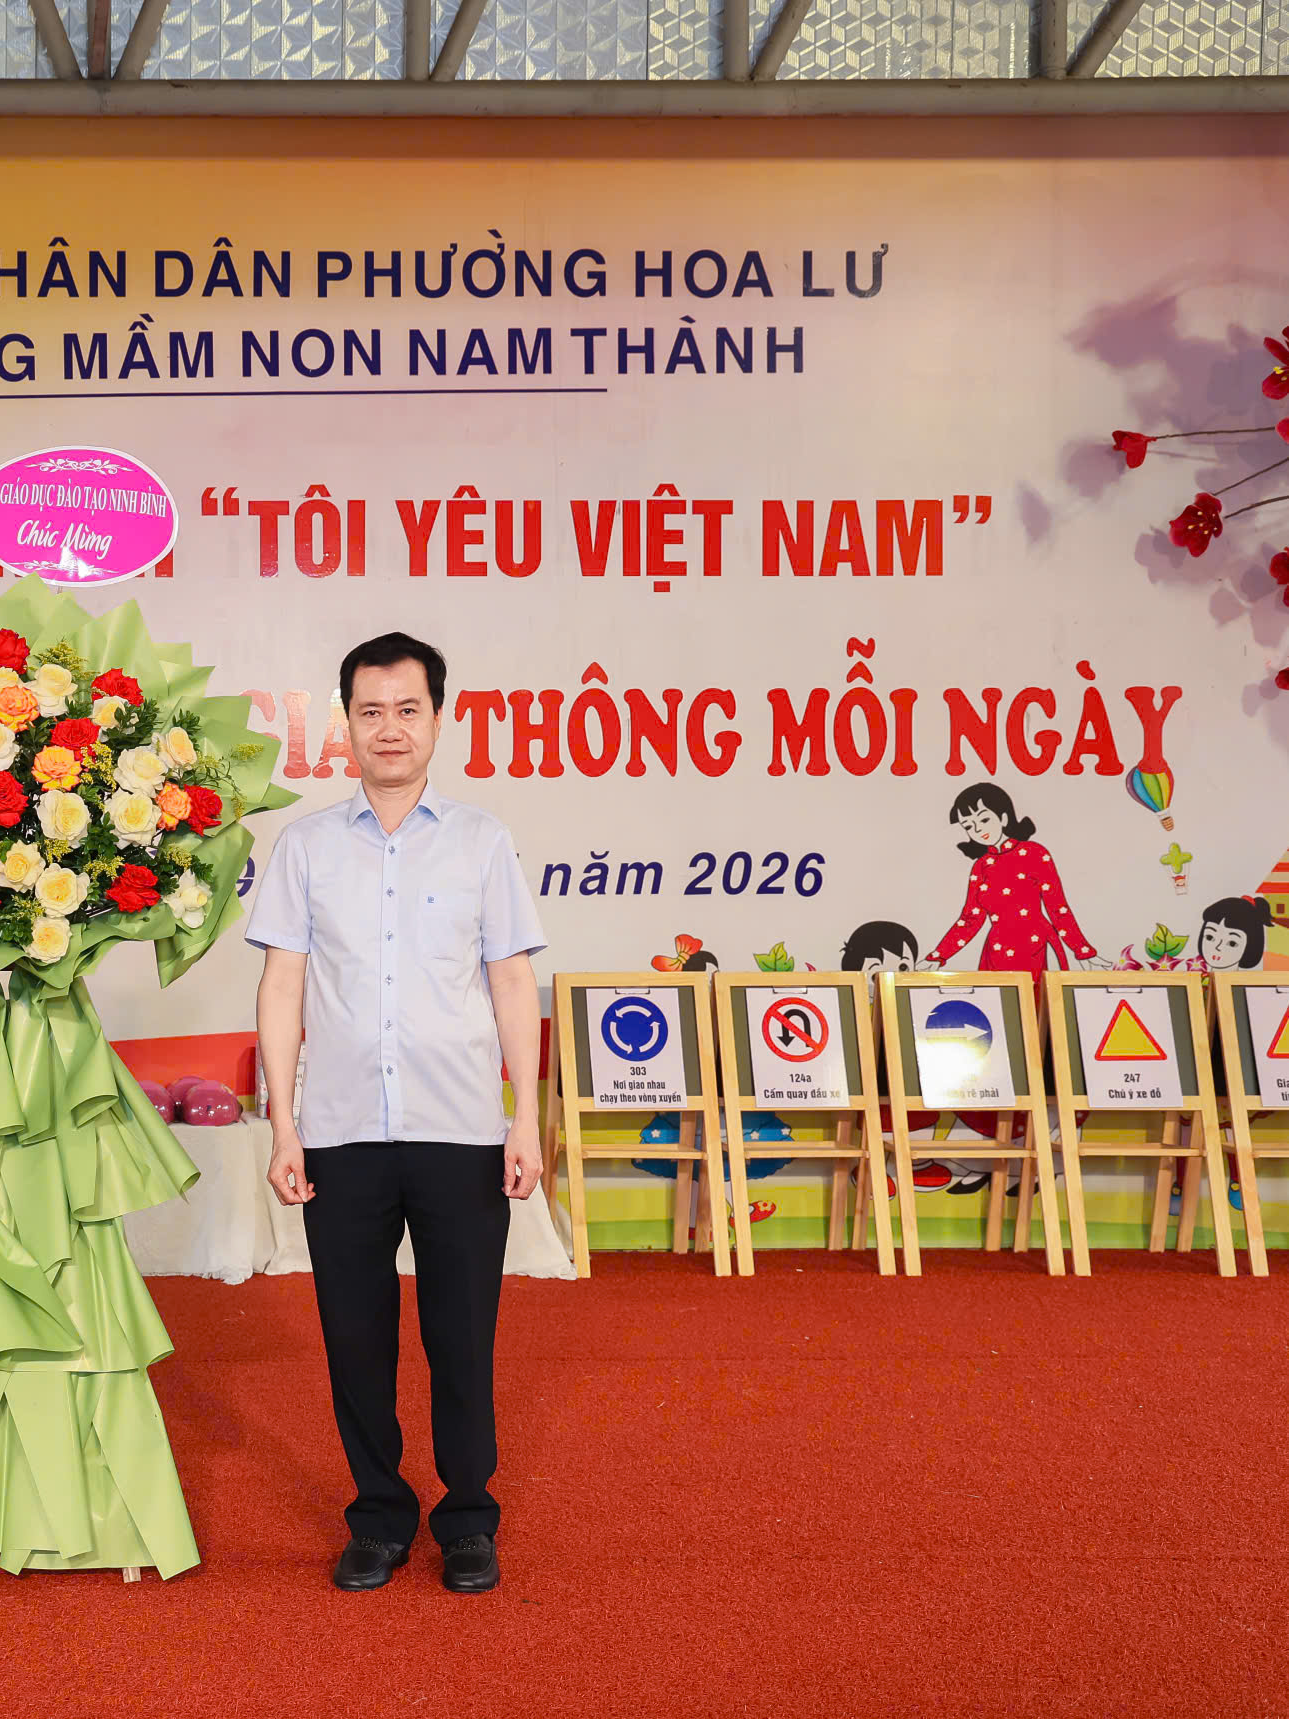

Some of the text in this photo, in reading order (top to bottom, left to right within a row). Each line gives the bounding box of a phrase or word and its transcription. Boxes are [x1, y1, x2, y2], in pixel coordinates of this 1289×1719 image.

[154, 237, 291, 299] DÂN
[316, 229, 607, 299] PHƯỜNG
[635, 249, 773, 299] HOA
[801, 242, 889, 299] LƯ
[63, 314, 214, 381] MẦM
[241, 328, 382, 378] NON
[408, 326, 553, 377] NAM
[569, 315, 805, 375] THÀNH
[0, 477, 30, 506] GIÁO
[31, 483, 56, 512] DỤC
[56, 478, 82, 509] ĐÀO
[83, 487, 107, 516] TẠO
[108, 488, 138, 513] NINH
[139, 486, 168, 518] BÌNH
[16, 519, 60, 548] Chúc
[60, 522, 113, 560] Mừng
[395, 485, 542, 578] YÊU
[570, 482, 734, 593] VIỆT
[454, 661, 743, 779] THÔNG
[767, 636, 919, 778] MỖI
[943, 659, 1184, 778] NGÀY
[539, 850, 827, 898] năm 2026
[630, 1066, 647, 1076] 303
[789, 1073, 812, 1083] 124a
[1123, 1073, 1141, 1083] 247
[613, 1080, 666, 1091] Nơi giao nhau
[599, 1091, 682, 1104] chạy theo vòng xuyến
[763, 1088, 784, 1099] Cấm
[786, 1089, 808, 1100] quay
[829, 1090, 840, 1099] xe
[979, 1087, 1000, 1099] phải
[1108, 1089, 1127, 1099] Chú
[1127, 1089, 1134, 1100] ý
[1136, 1090, 1148, 1099] xe
